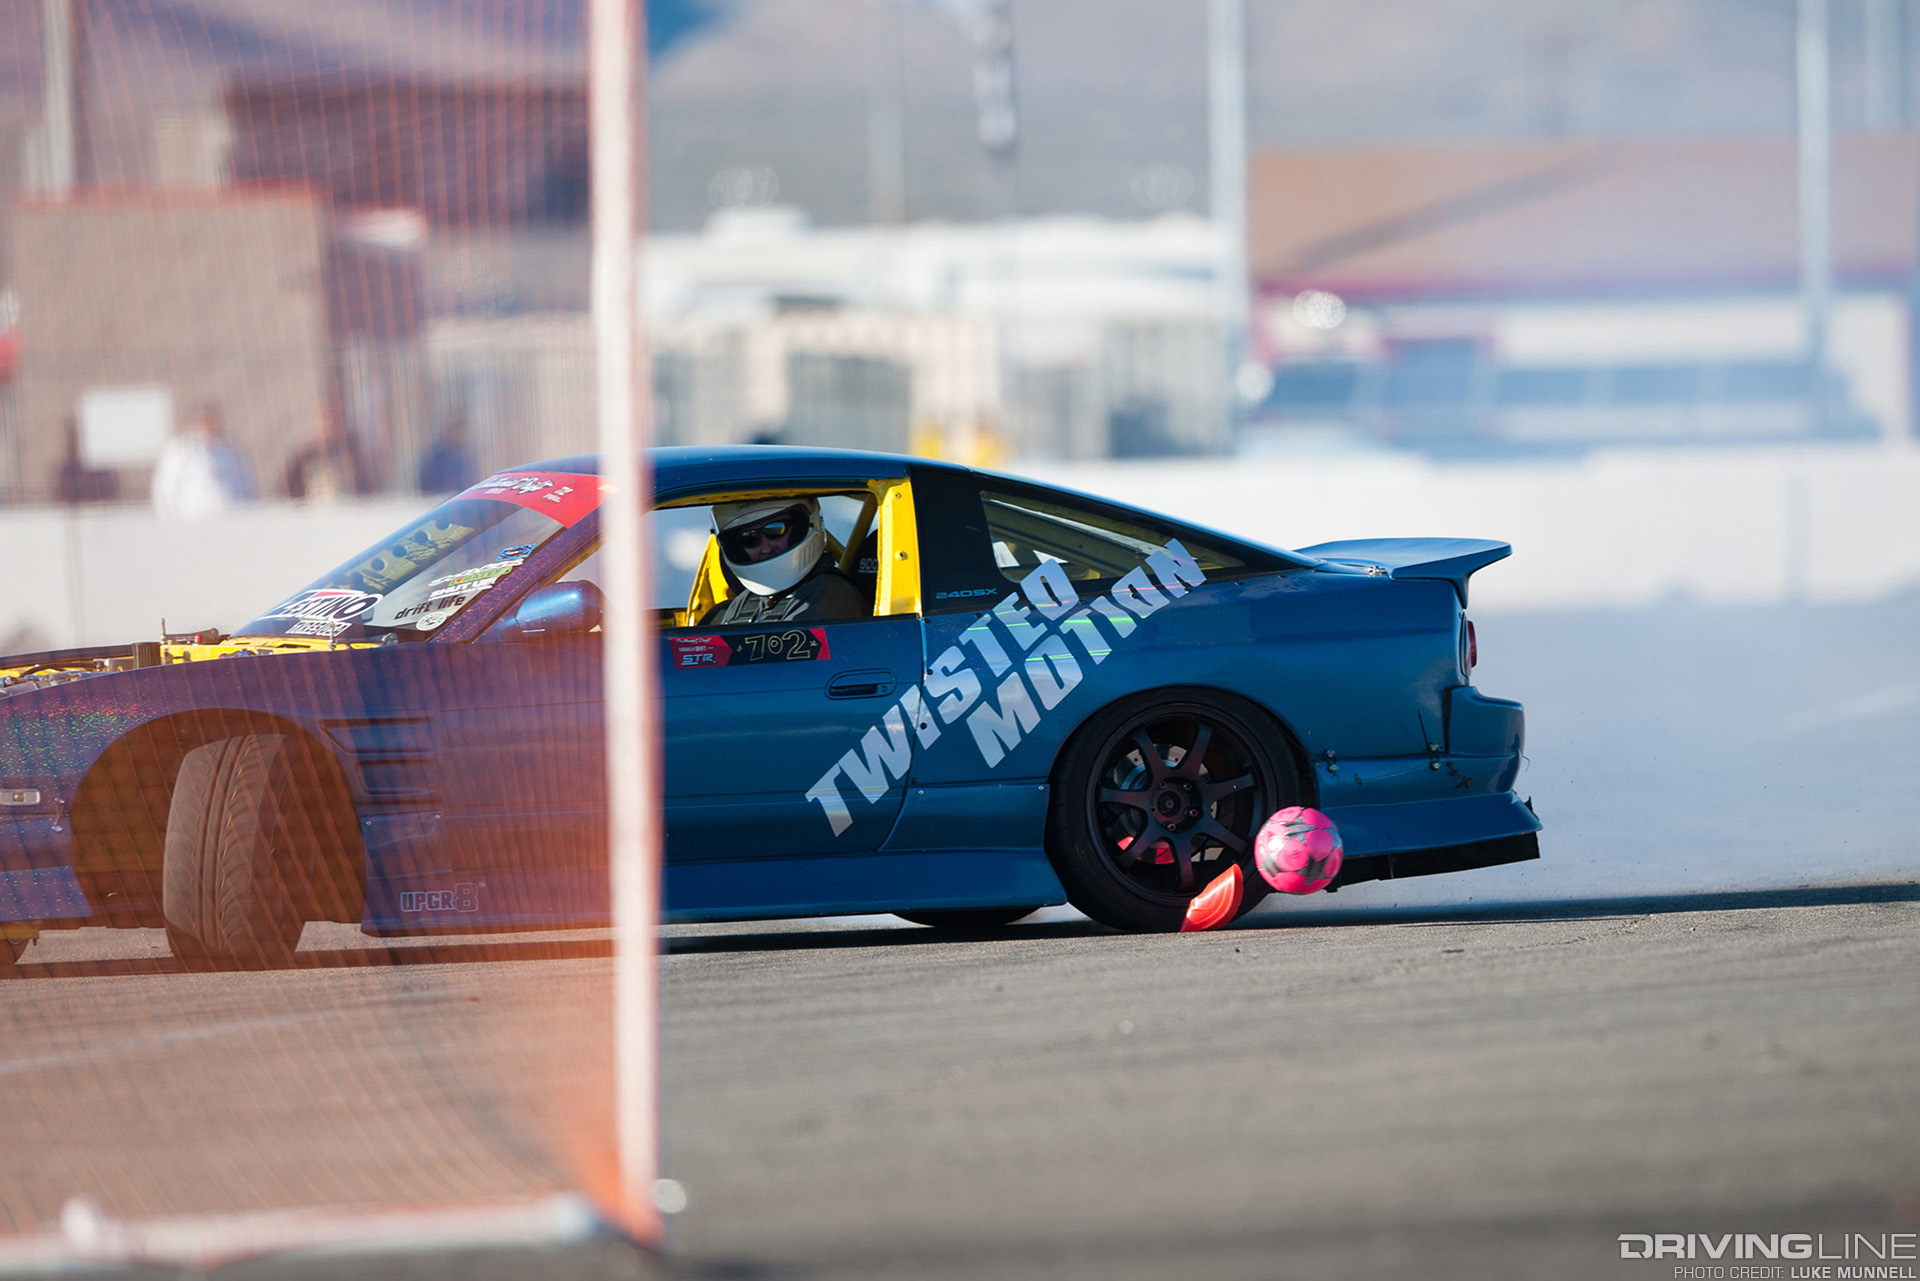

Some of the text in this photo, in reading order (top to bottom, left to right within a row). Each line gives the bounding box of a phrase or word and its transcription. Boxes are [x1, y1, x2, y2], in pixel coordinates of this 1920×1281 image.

[257, 589, 383, 622] ZESTINO
[394, 594, 467, 620] drift life
[935, 588, 999, 599] 240SX
[745, 629, 811, 662] 702
[966, 538, 1207, 769] MOTION
[805, 557, 1082, 837] TWISTED
